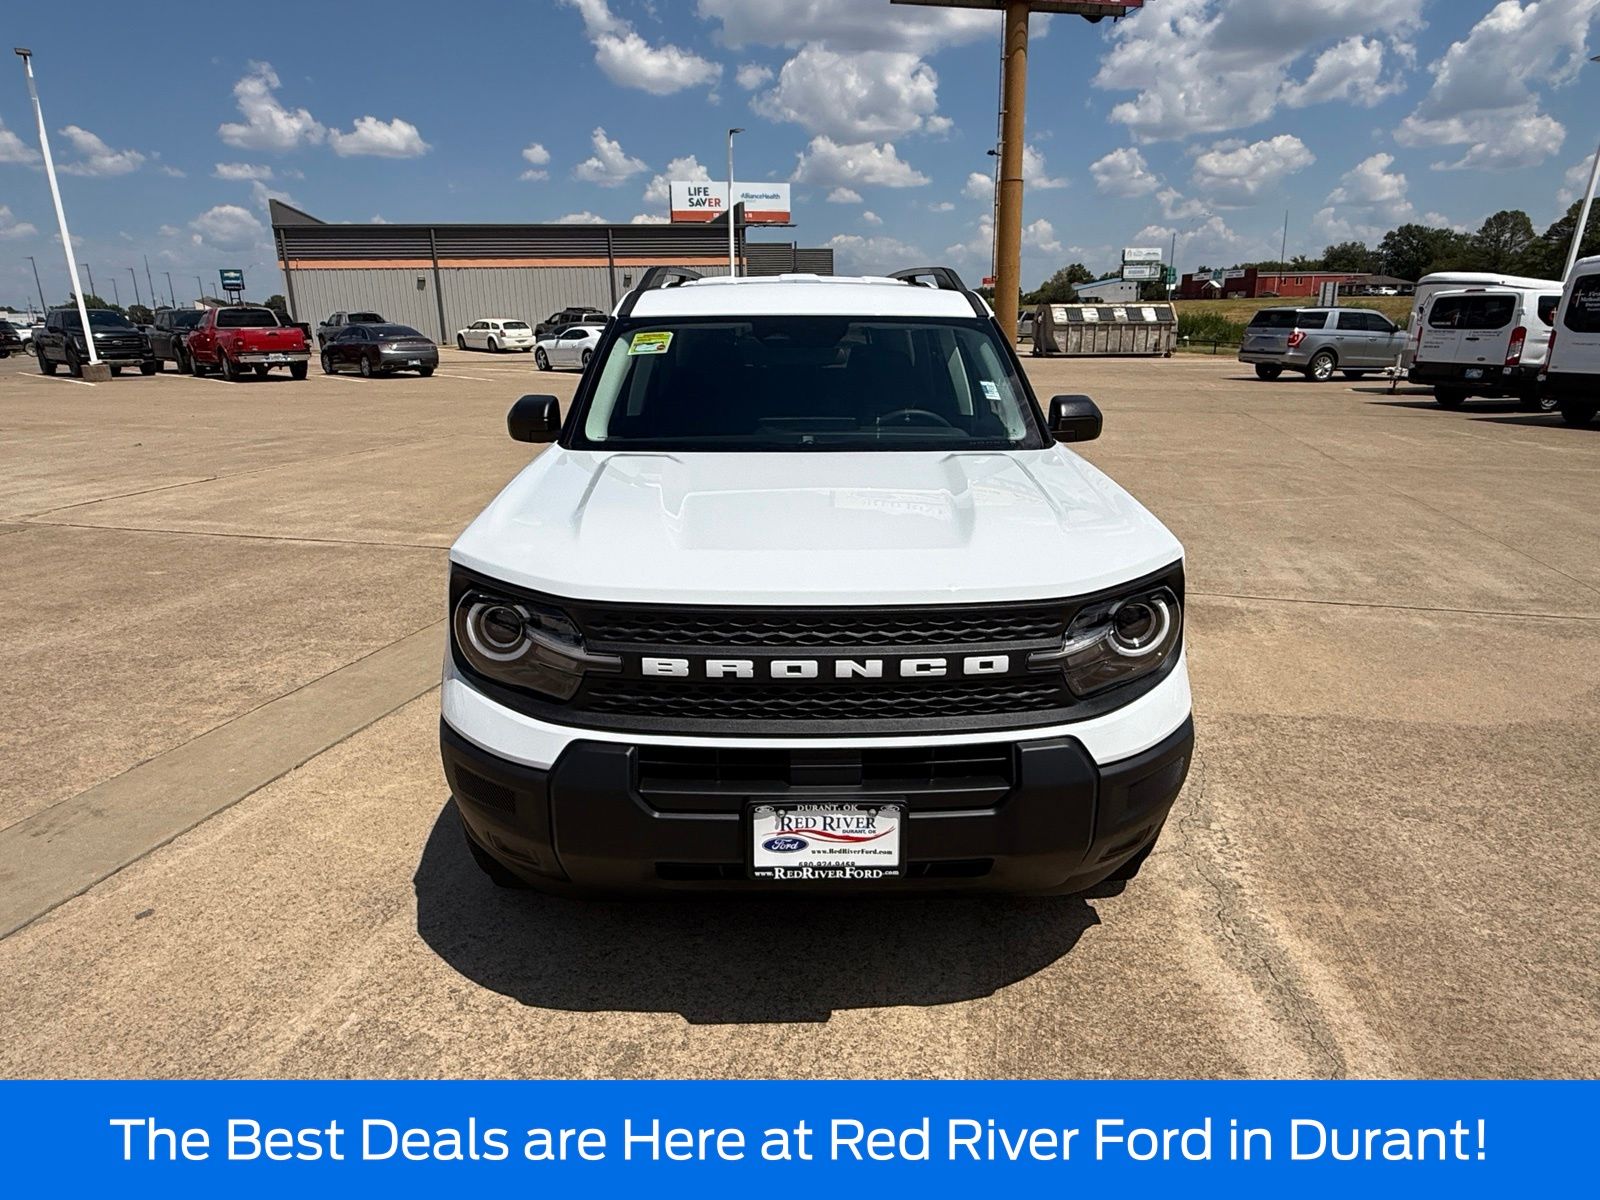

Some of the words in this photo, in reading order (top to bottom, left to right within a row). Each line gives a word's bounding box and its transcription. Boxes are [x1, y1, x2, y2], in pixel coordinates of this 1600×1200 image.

[688, 187, 709, 196] LIFE
[688, 198, 721, 207] SAVER
[641, 655, 1010, 679] BRONCO
[780, 816, 817, 832] RED
[821, 816, 876, 831] RIVER
[771, 840, 799, 850] Ford
